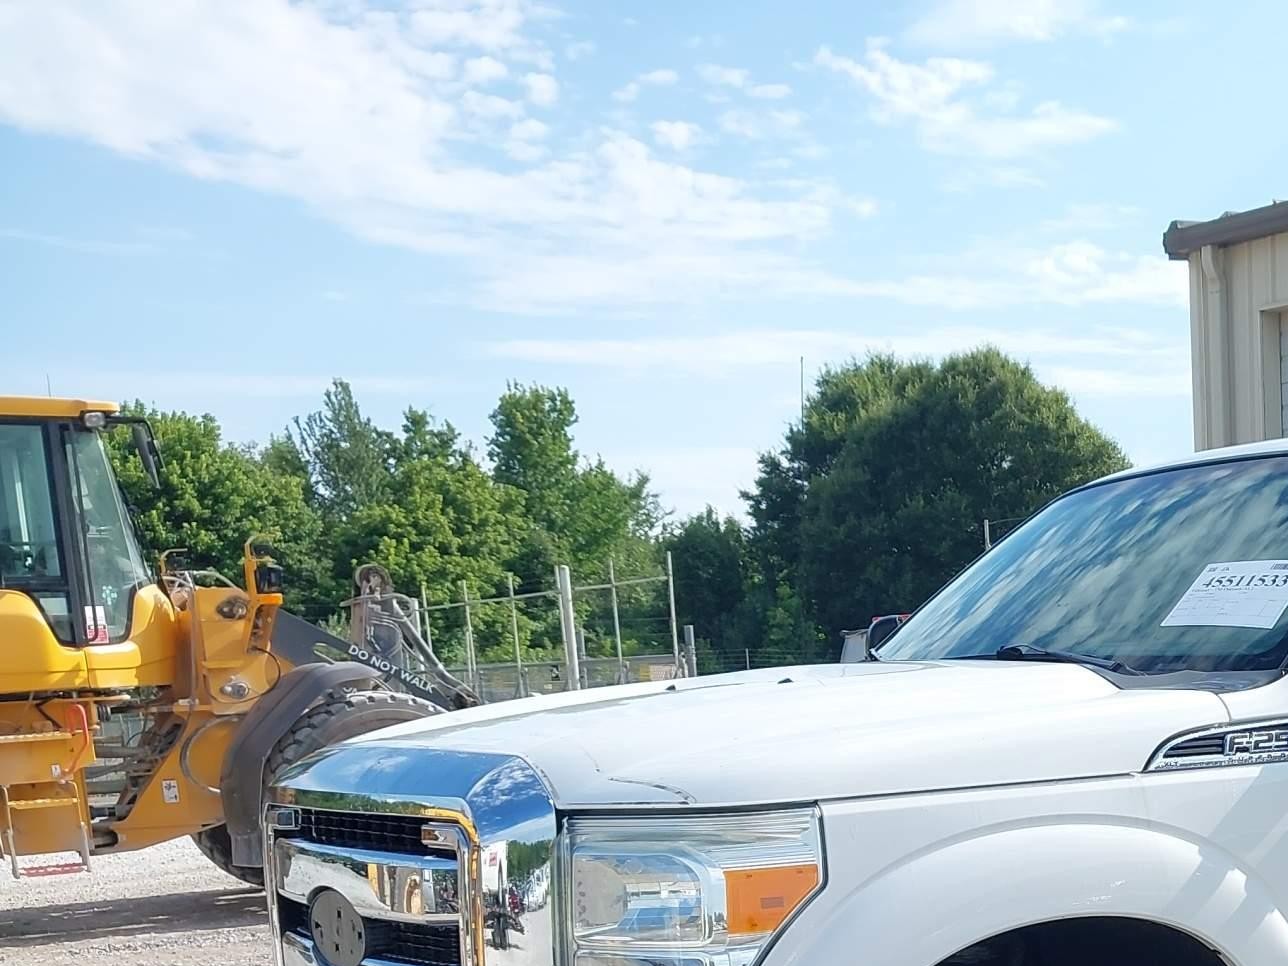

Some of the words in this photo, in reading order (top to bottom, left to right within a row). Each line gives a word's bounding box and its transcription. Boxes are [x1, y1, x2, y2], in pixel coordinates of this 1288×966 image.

[348, 645, 369, 660] DO
[370, 656, 399, 675] NOT
[400, 670, 433, 694] WALK
